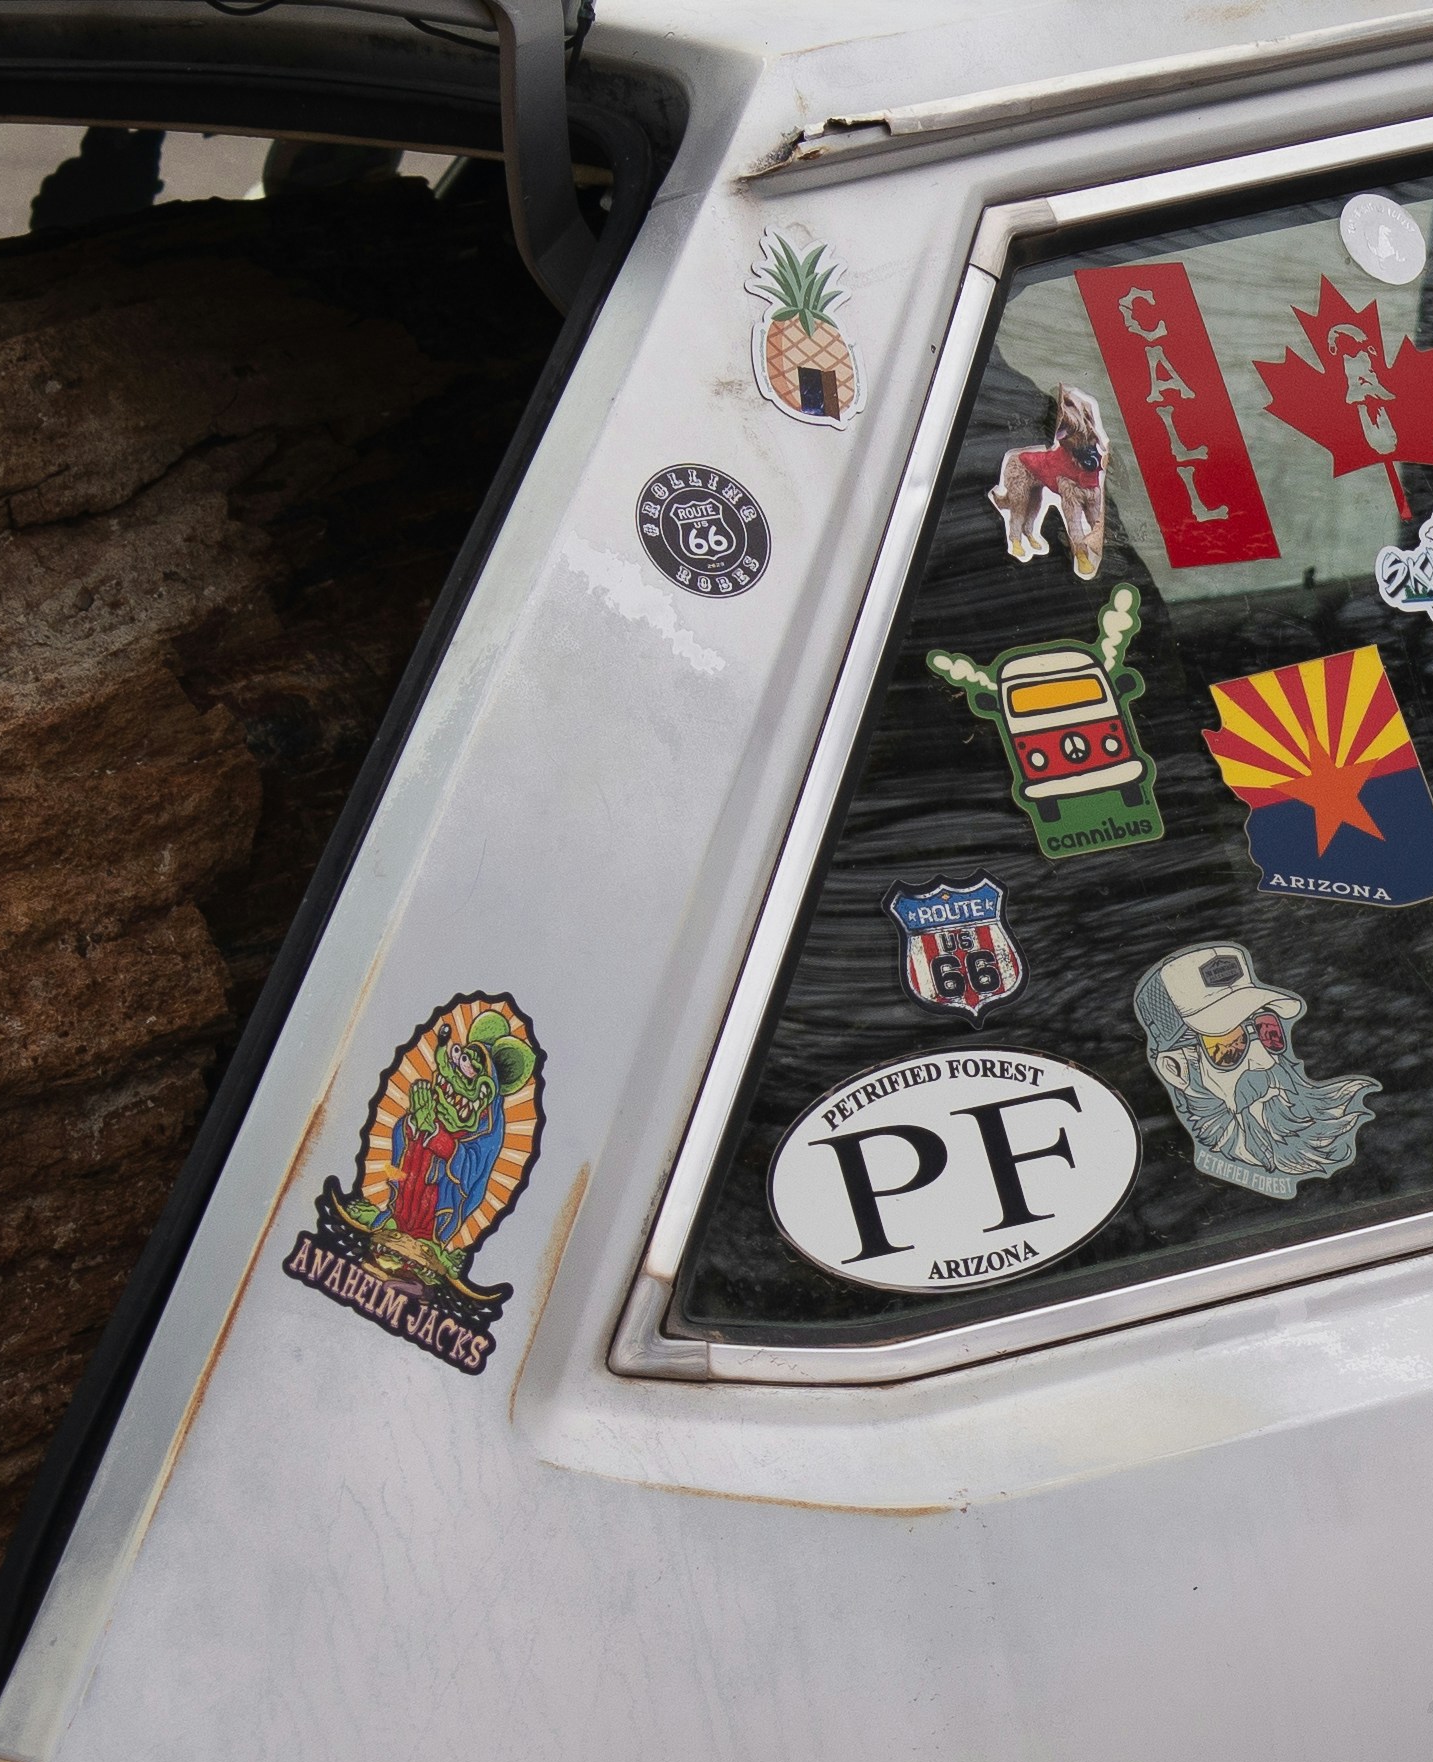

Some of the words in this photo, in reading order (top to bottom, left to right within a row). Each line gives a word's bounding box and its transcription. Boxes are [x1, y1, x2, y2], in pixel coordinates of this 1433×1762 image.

[1118, 285, 1229, 522] CALL
[677, 503, 716, 520] ROUTE
[693, 520, 709, 529] US
[688, 525, 729, 555] 66
[675, 555, 760, 593] ROBES
[1046, 816, 1153, 851] cannibus
[1269, 873, 1393, 901] ARIZONA
[917, 898, 985, 924] ROUTE
[939, 931, 974, 953] US
[930, 949, 1002, 998] 66
[821, 1062, 942, 1132] PETRIFIED
[947, 1058, 1044, 1088] FOREST
[808, 1086, 1083, 1265] PF
[1196, 1150, 1250, 1184] PETRIFIED
[1251, 1173, 1292, 1194] FOREST
[927, 1240, 1040, 1281] ARIZONA
[290, 1238, 408, 1329] ANAHEIM
[406, 1304, 489, 1368] JACKS
